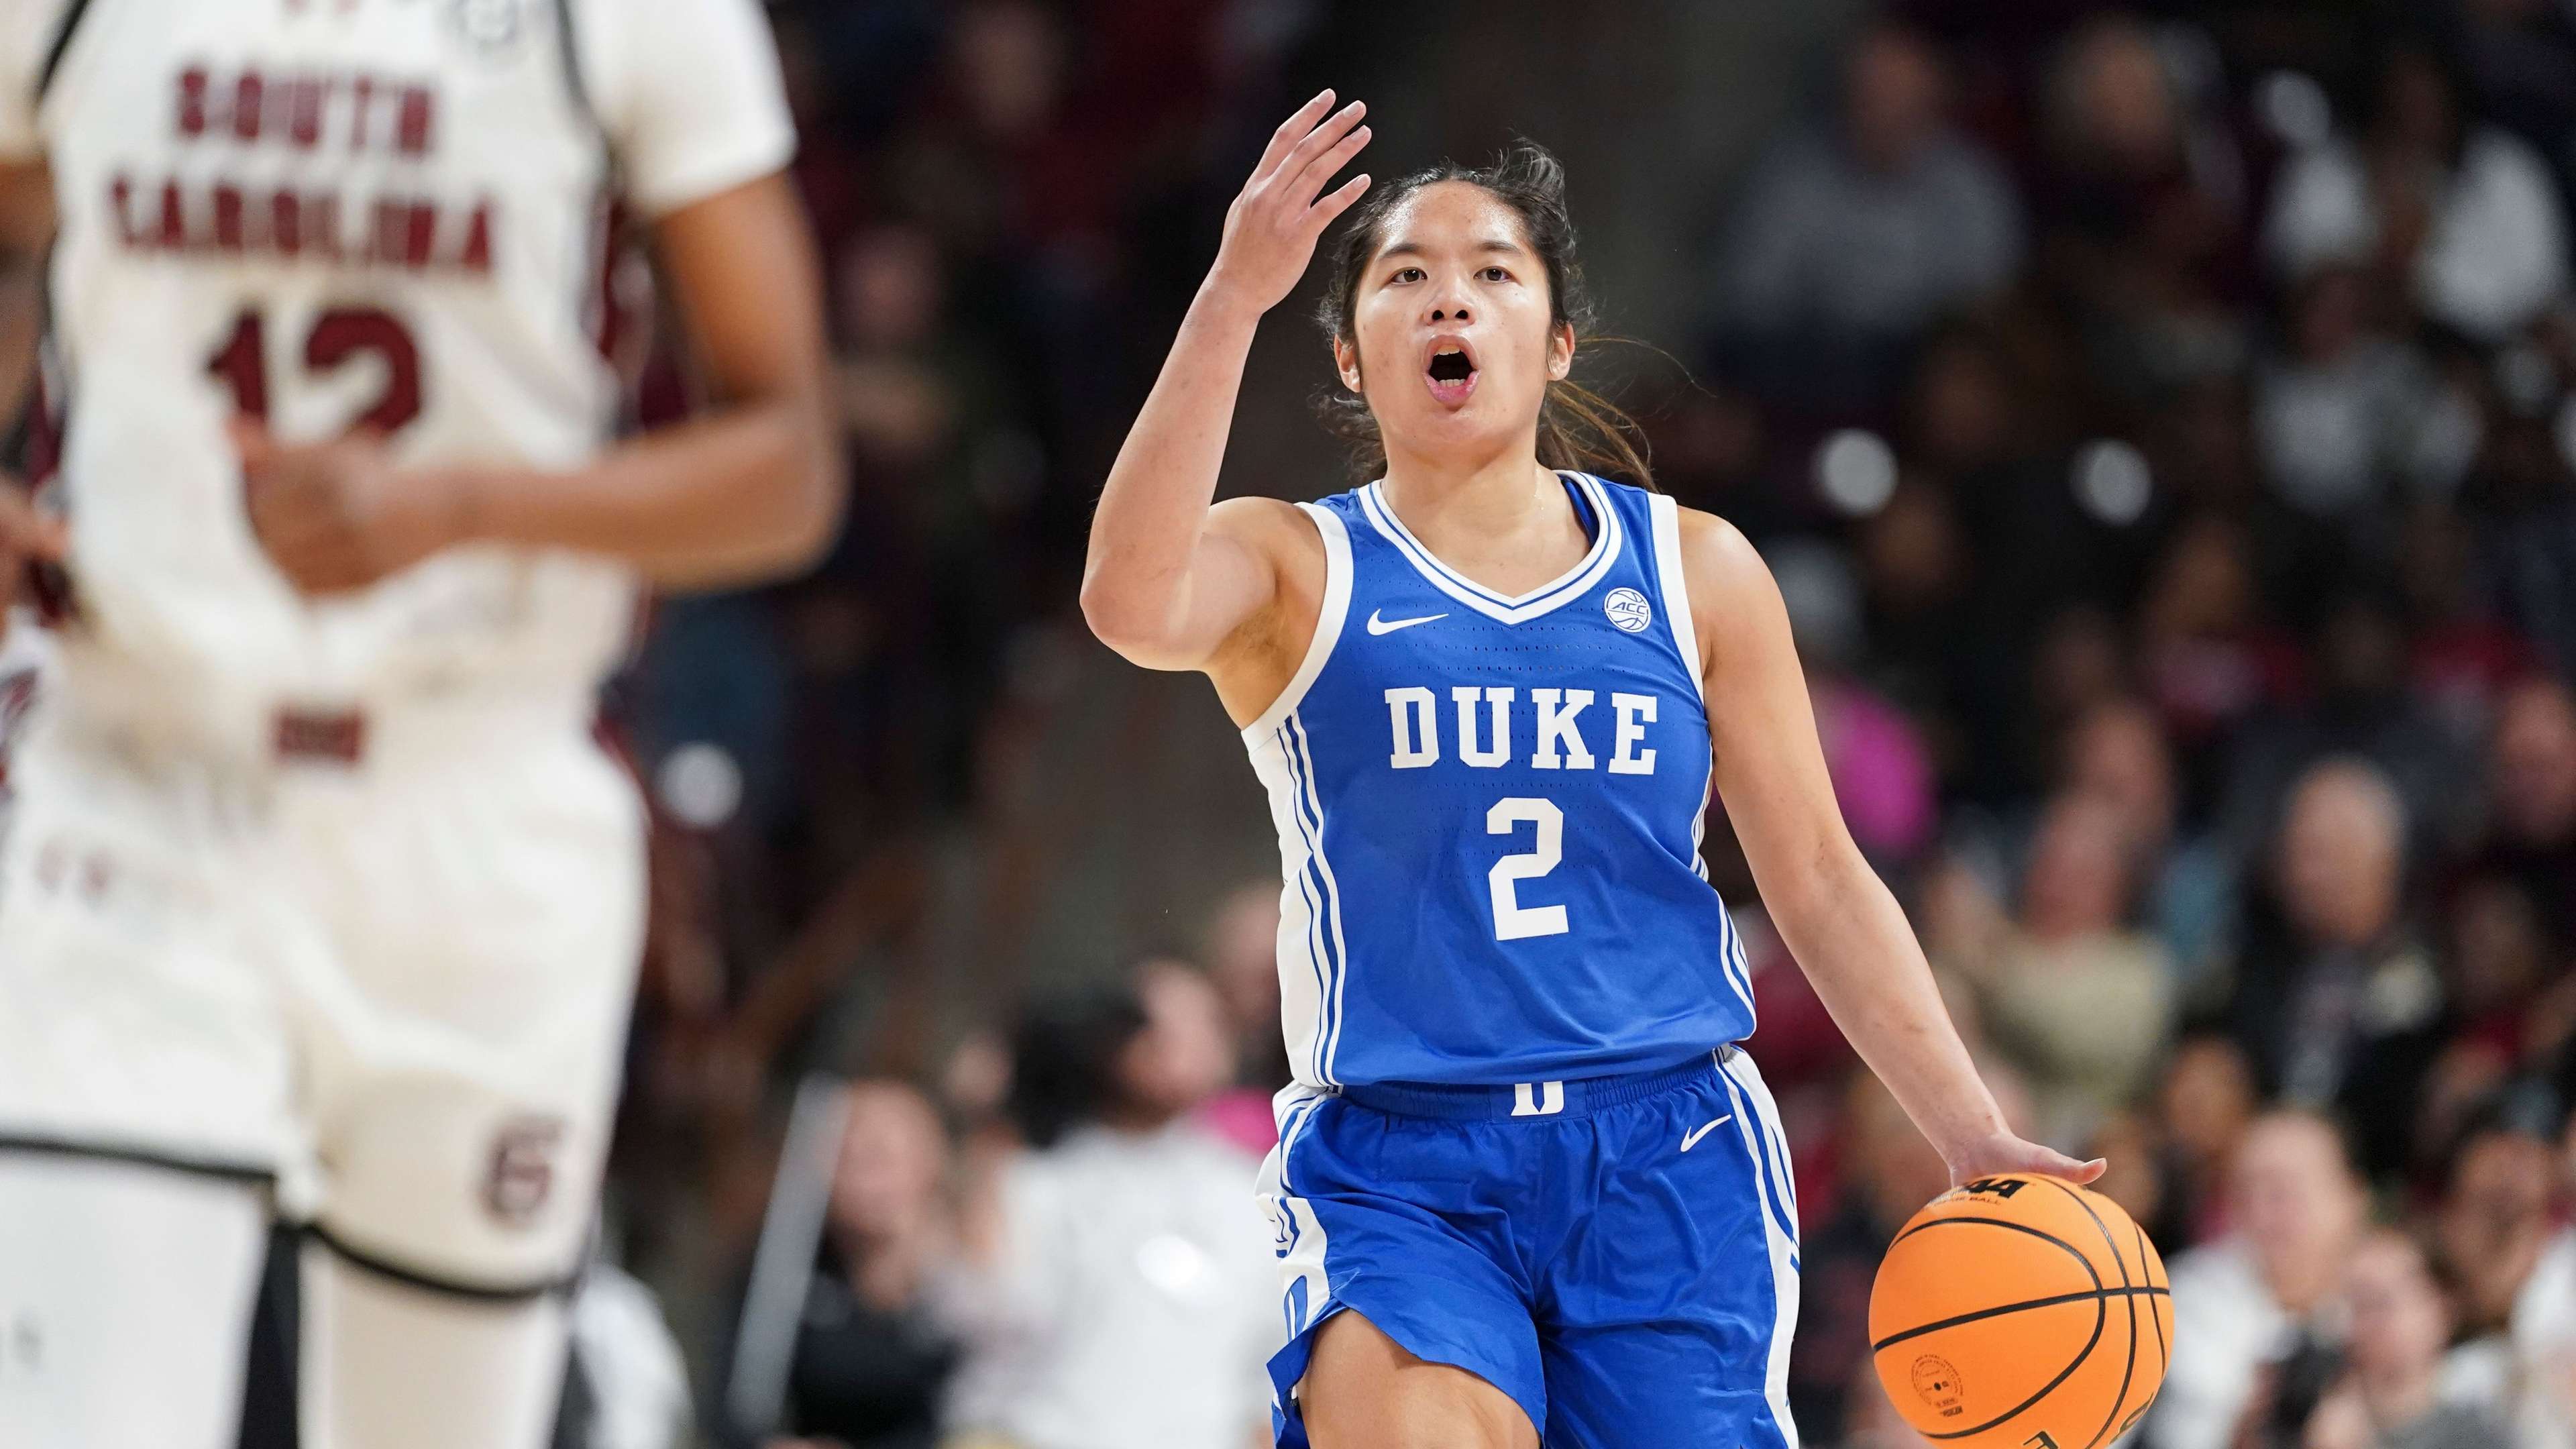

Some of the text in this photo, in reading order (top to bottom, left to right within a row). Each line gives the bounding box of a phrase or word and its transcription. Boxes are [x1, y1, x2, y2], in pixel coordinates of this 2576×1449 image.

[176, 65, 433, 154] SOUTH
[109, 174, 492, 272] CAROLINA
[207, 307, 424, 435] 12
[1611, 601, 1647, 615] ACC
[1384, 686, 1658, 775] DUKE
[1487, 797, 1570, 941] 2
